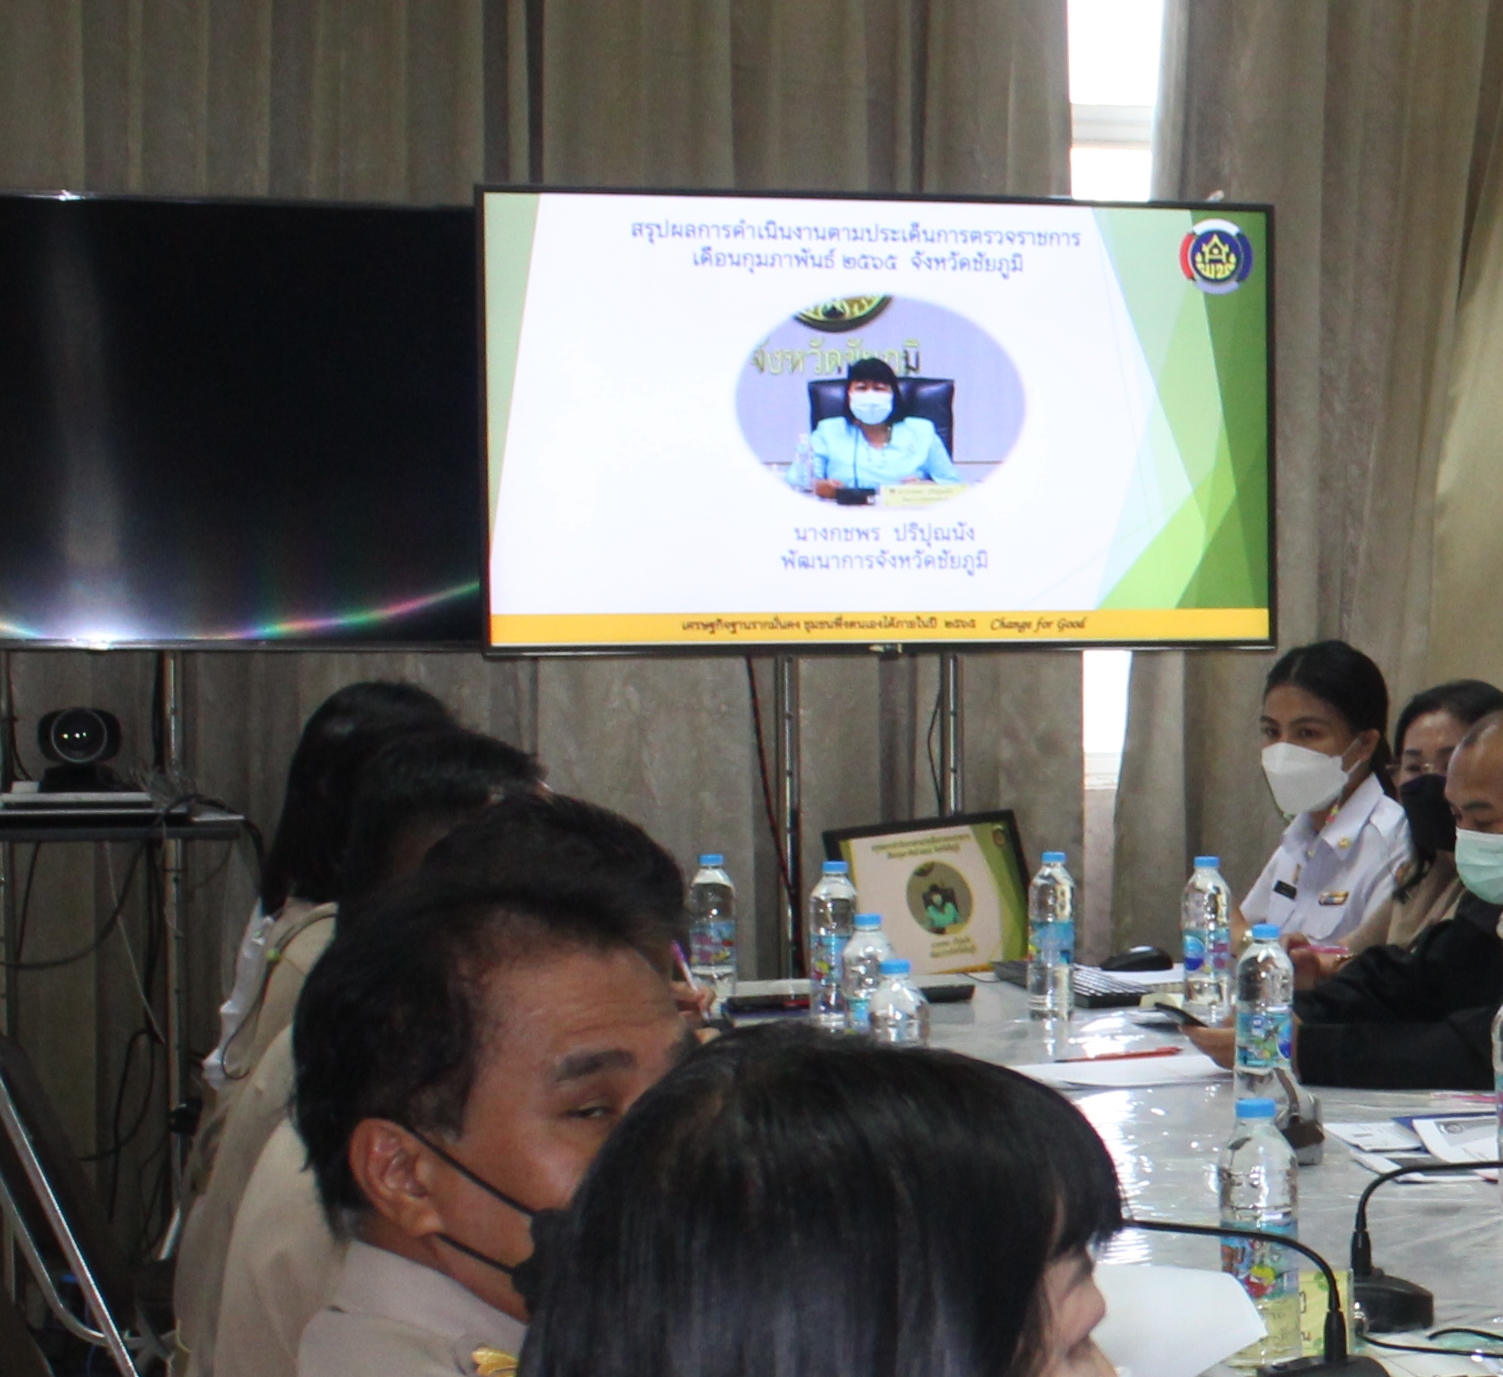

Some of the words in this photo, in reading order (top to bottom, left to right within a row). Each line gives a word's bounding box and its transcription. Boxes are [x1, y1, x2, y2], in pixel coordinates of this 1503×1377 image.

[631, 219, 1081, 248] สรุปผลการดำเนินงานตามประเด็นการตรวจราชการ
[693, 249, 836, 275] เดือนกุมภาพันธ์
[842, 253, 898, 272] ๒๕๖๕
[910, 251, 1024, 280] จังหวัดชัยภูมิ
[752, 338, 920, 375] จังหวัดชัภมิ
[793, 524, 881, 543] นางกชพร
[781, 549, 988, 577] พัฒนาการจังหวัดชัยภูมิ
[990, 617, 1032, 633] Change
[1034, 616, 1053, 633] for
[1057, 616, 1087, 633] Good
